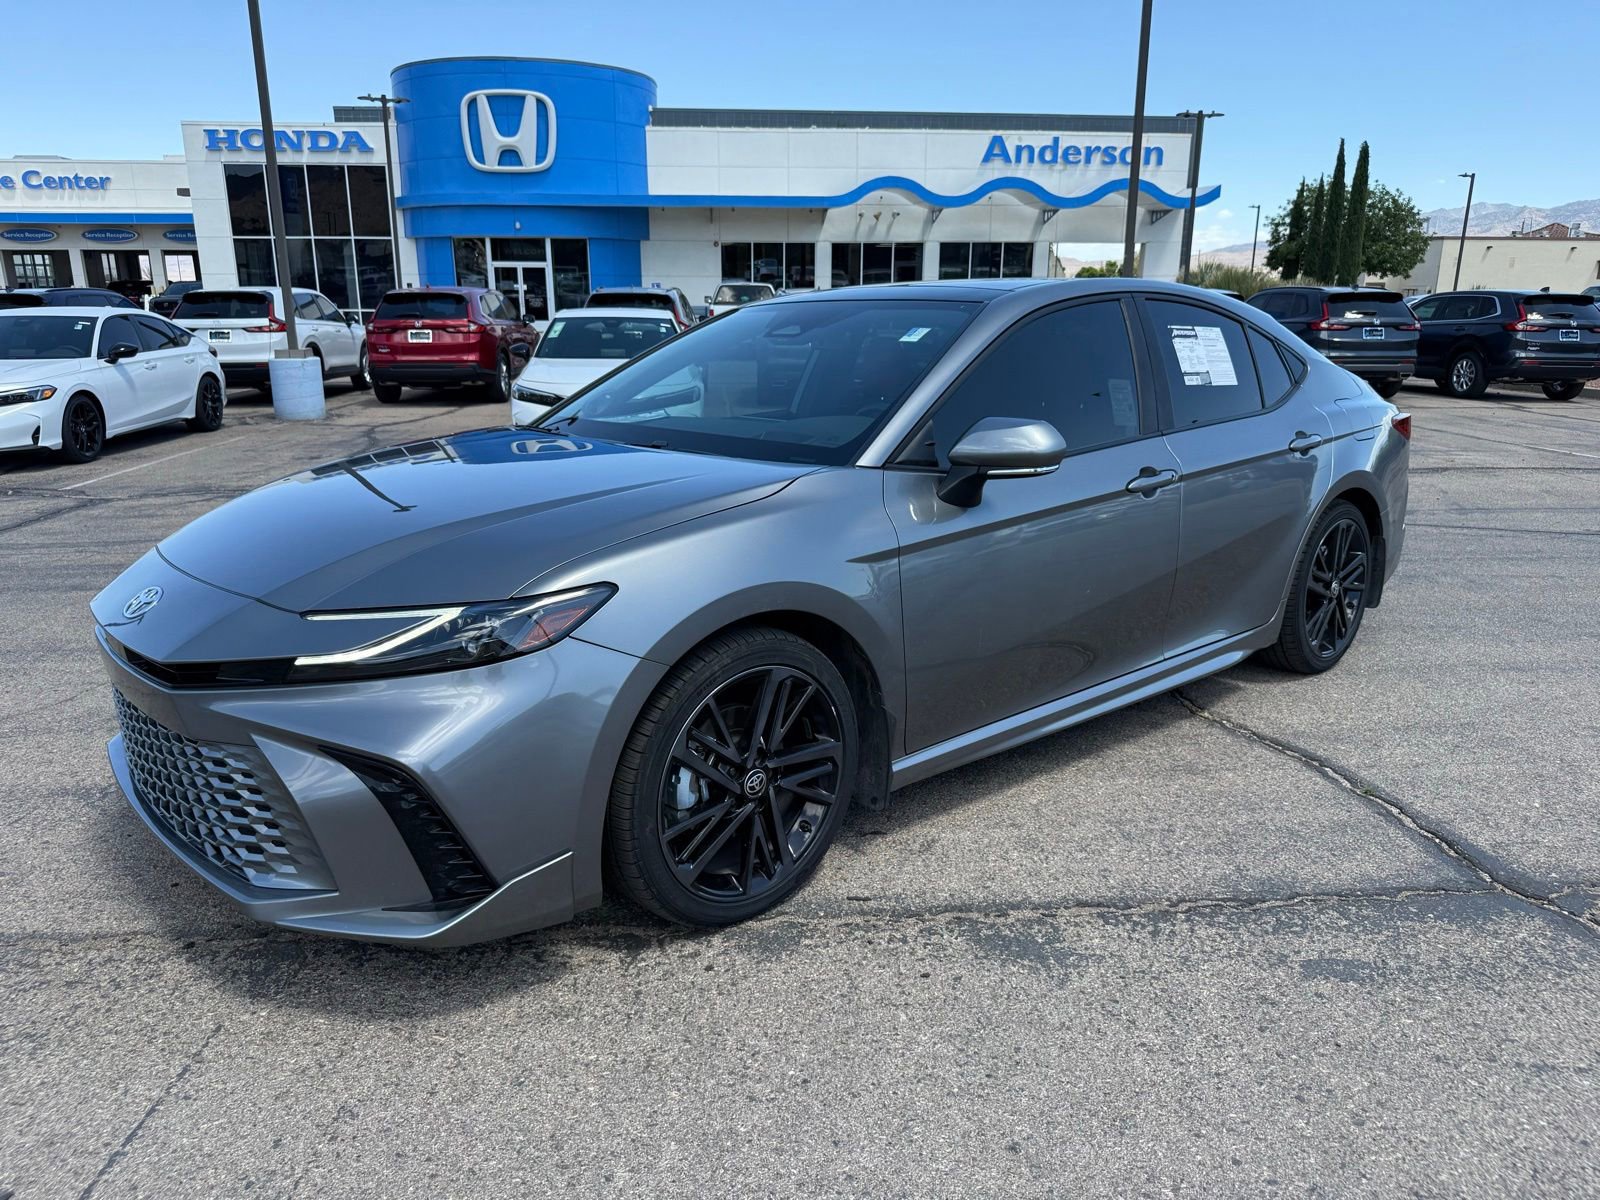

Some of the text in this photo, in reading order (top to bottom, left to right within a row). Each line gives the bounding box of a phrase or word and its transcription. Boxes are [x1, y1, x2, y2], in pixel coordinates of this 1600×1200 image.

[203, 128, 374, 152] HONDA
[981, 135, 1164, 166] Anderson
[21, 169, 112, 190] Center
[25, 231, 53, 239] Reception
